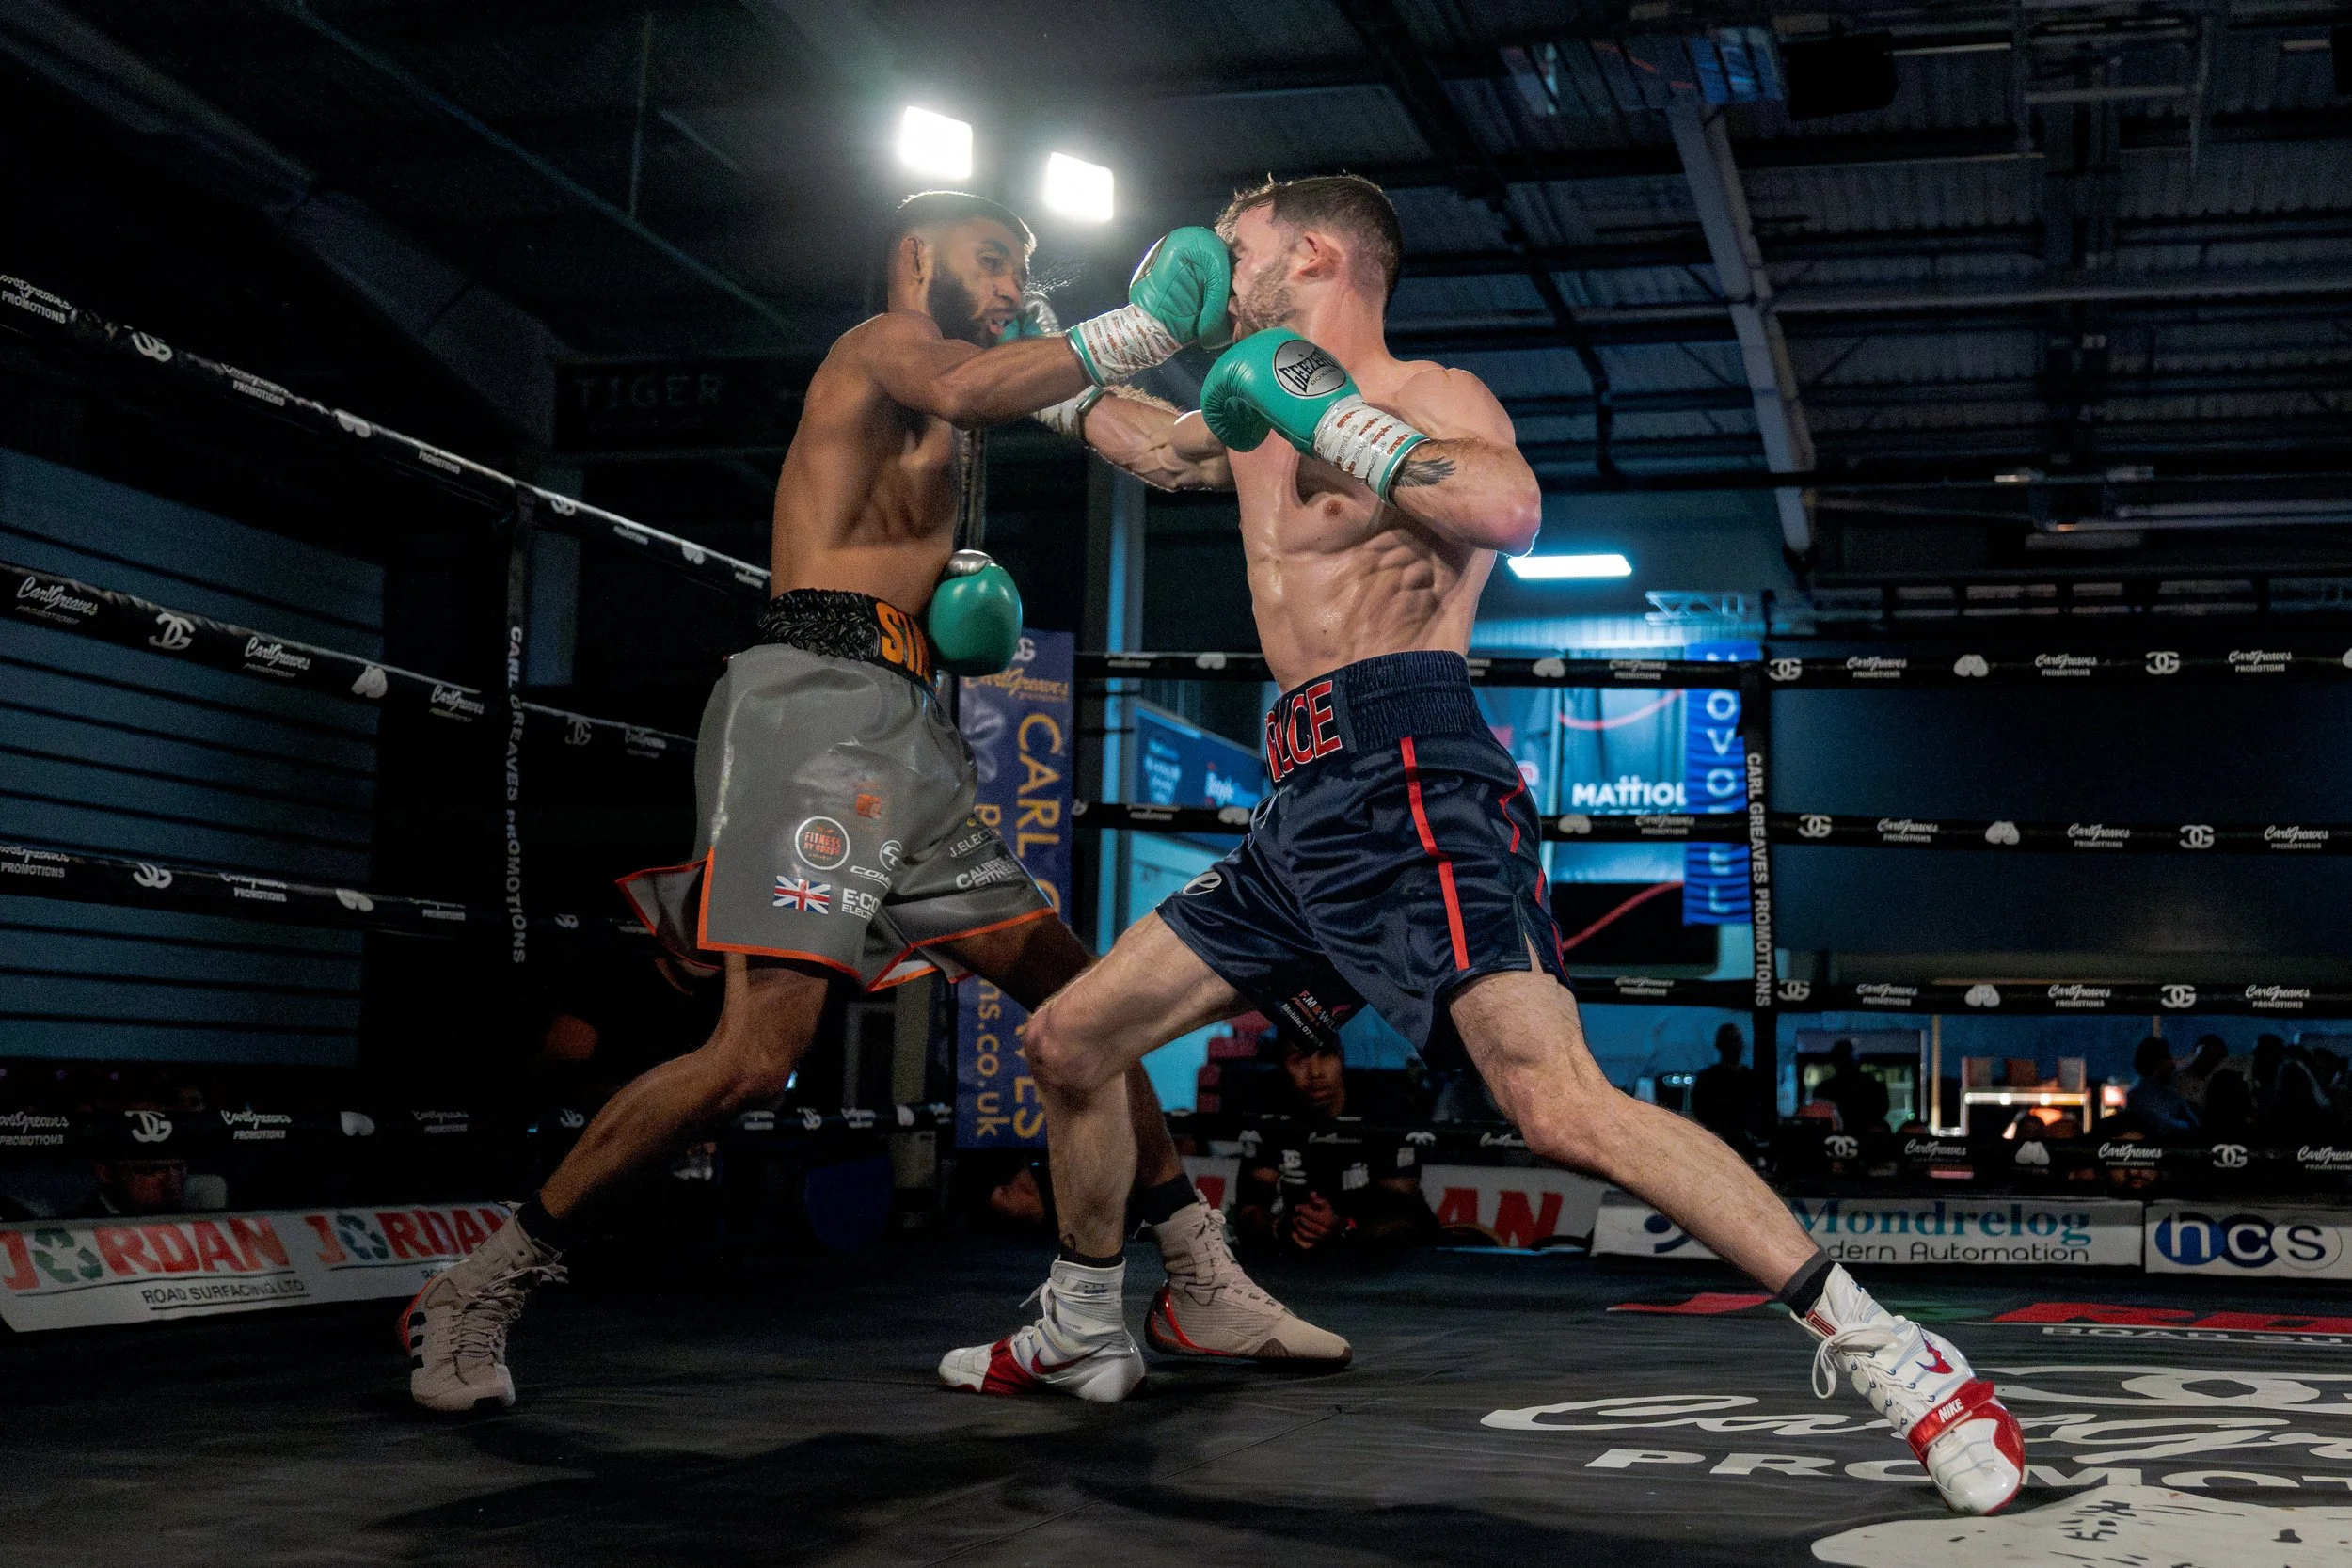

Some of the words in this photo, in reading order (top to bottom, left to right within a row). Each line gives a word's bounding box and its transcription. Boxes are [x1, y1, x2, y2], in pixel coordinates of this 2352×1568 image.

[1, 289, 67, 325] PROMOTIONS
[1016, 713, 1062, 858] CARL
[1747, 752, 1764, 800] CARL
[1749, 803, 1769, 884] GREAVES
[0, 861, 66, 879] PROMOTIONS
[1754, 888, 1772, 1006] PROMOTIONS
[1909, 1241, 2090, 1262] Automation
[141, 1286, 188, 1305] ROAD
[1937, 1397, 1965, 1423] NIKE
